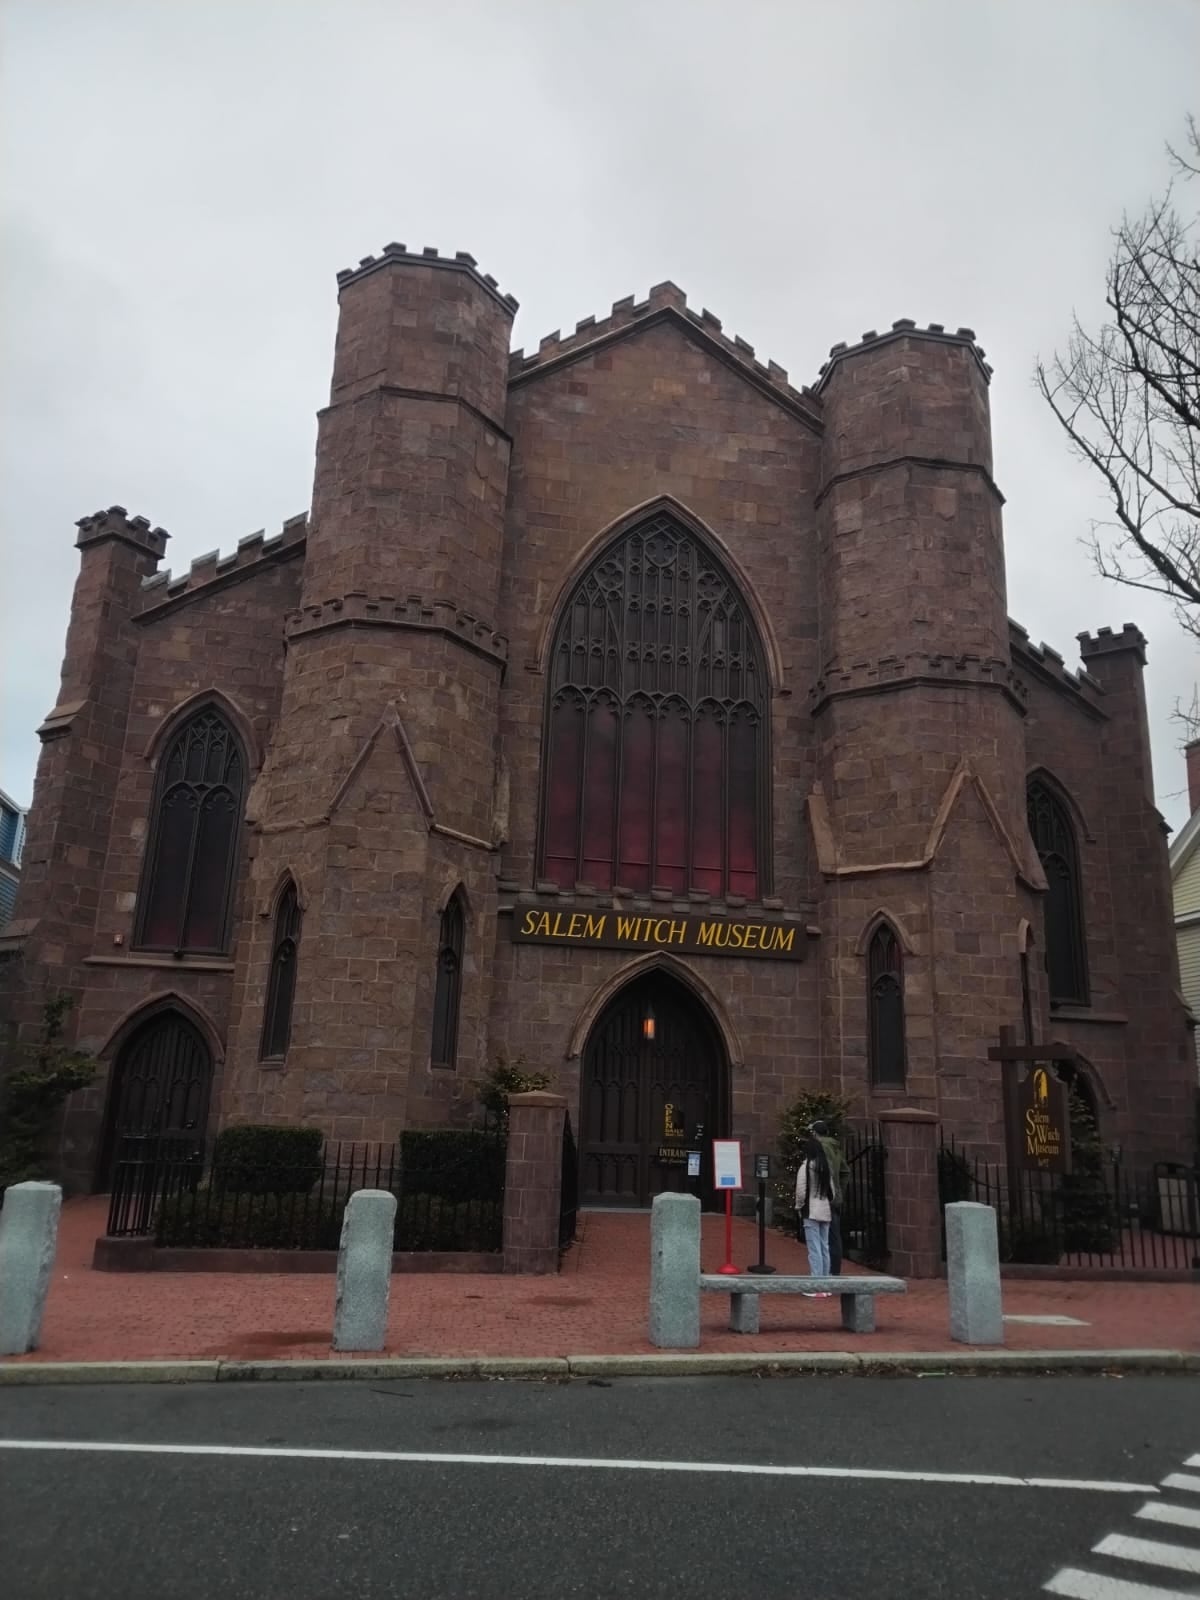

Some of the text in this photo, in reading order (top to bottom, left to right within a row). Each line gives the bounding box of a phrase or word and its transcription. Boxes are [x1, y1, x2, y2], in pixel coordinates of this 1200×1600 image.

[521, 910, 796, 951] SALEM WITCH MUSEUM
[664, 1103, 674, 1129] OPEN
[1026, 1108, 1049, 1136] Salem
[1027, 1136, 1059, 1156] Museum
[1036, 1125, 1060, 1144] Witch
[659, 1148, 688, 1158] ENTRAN
